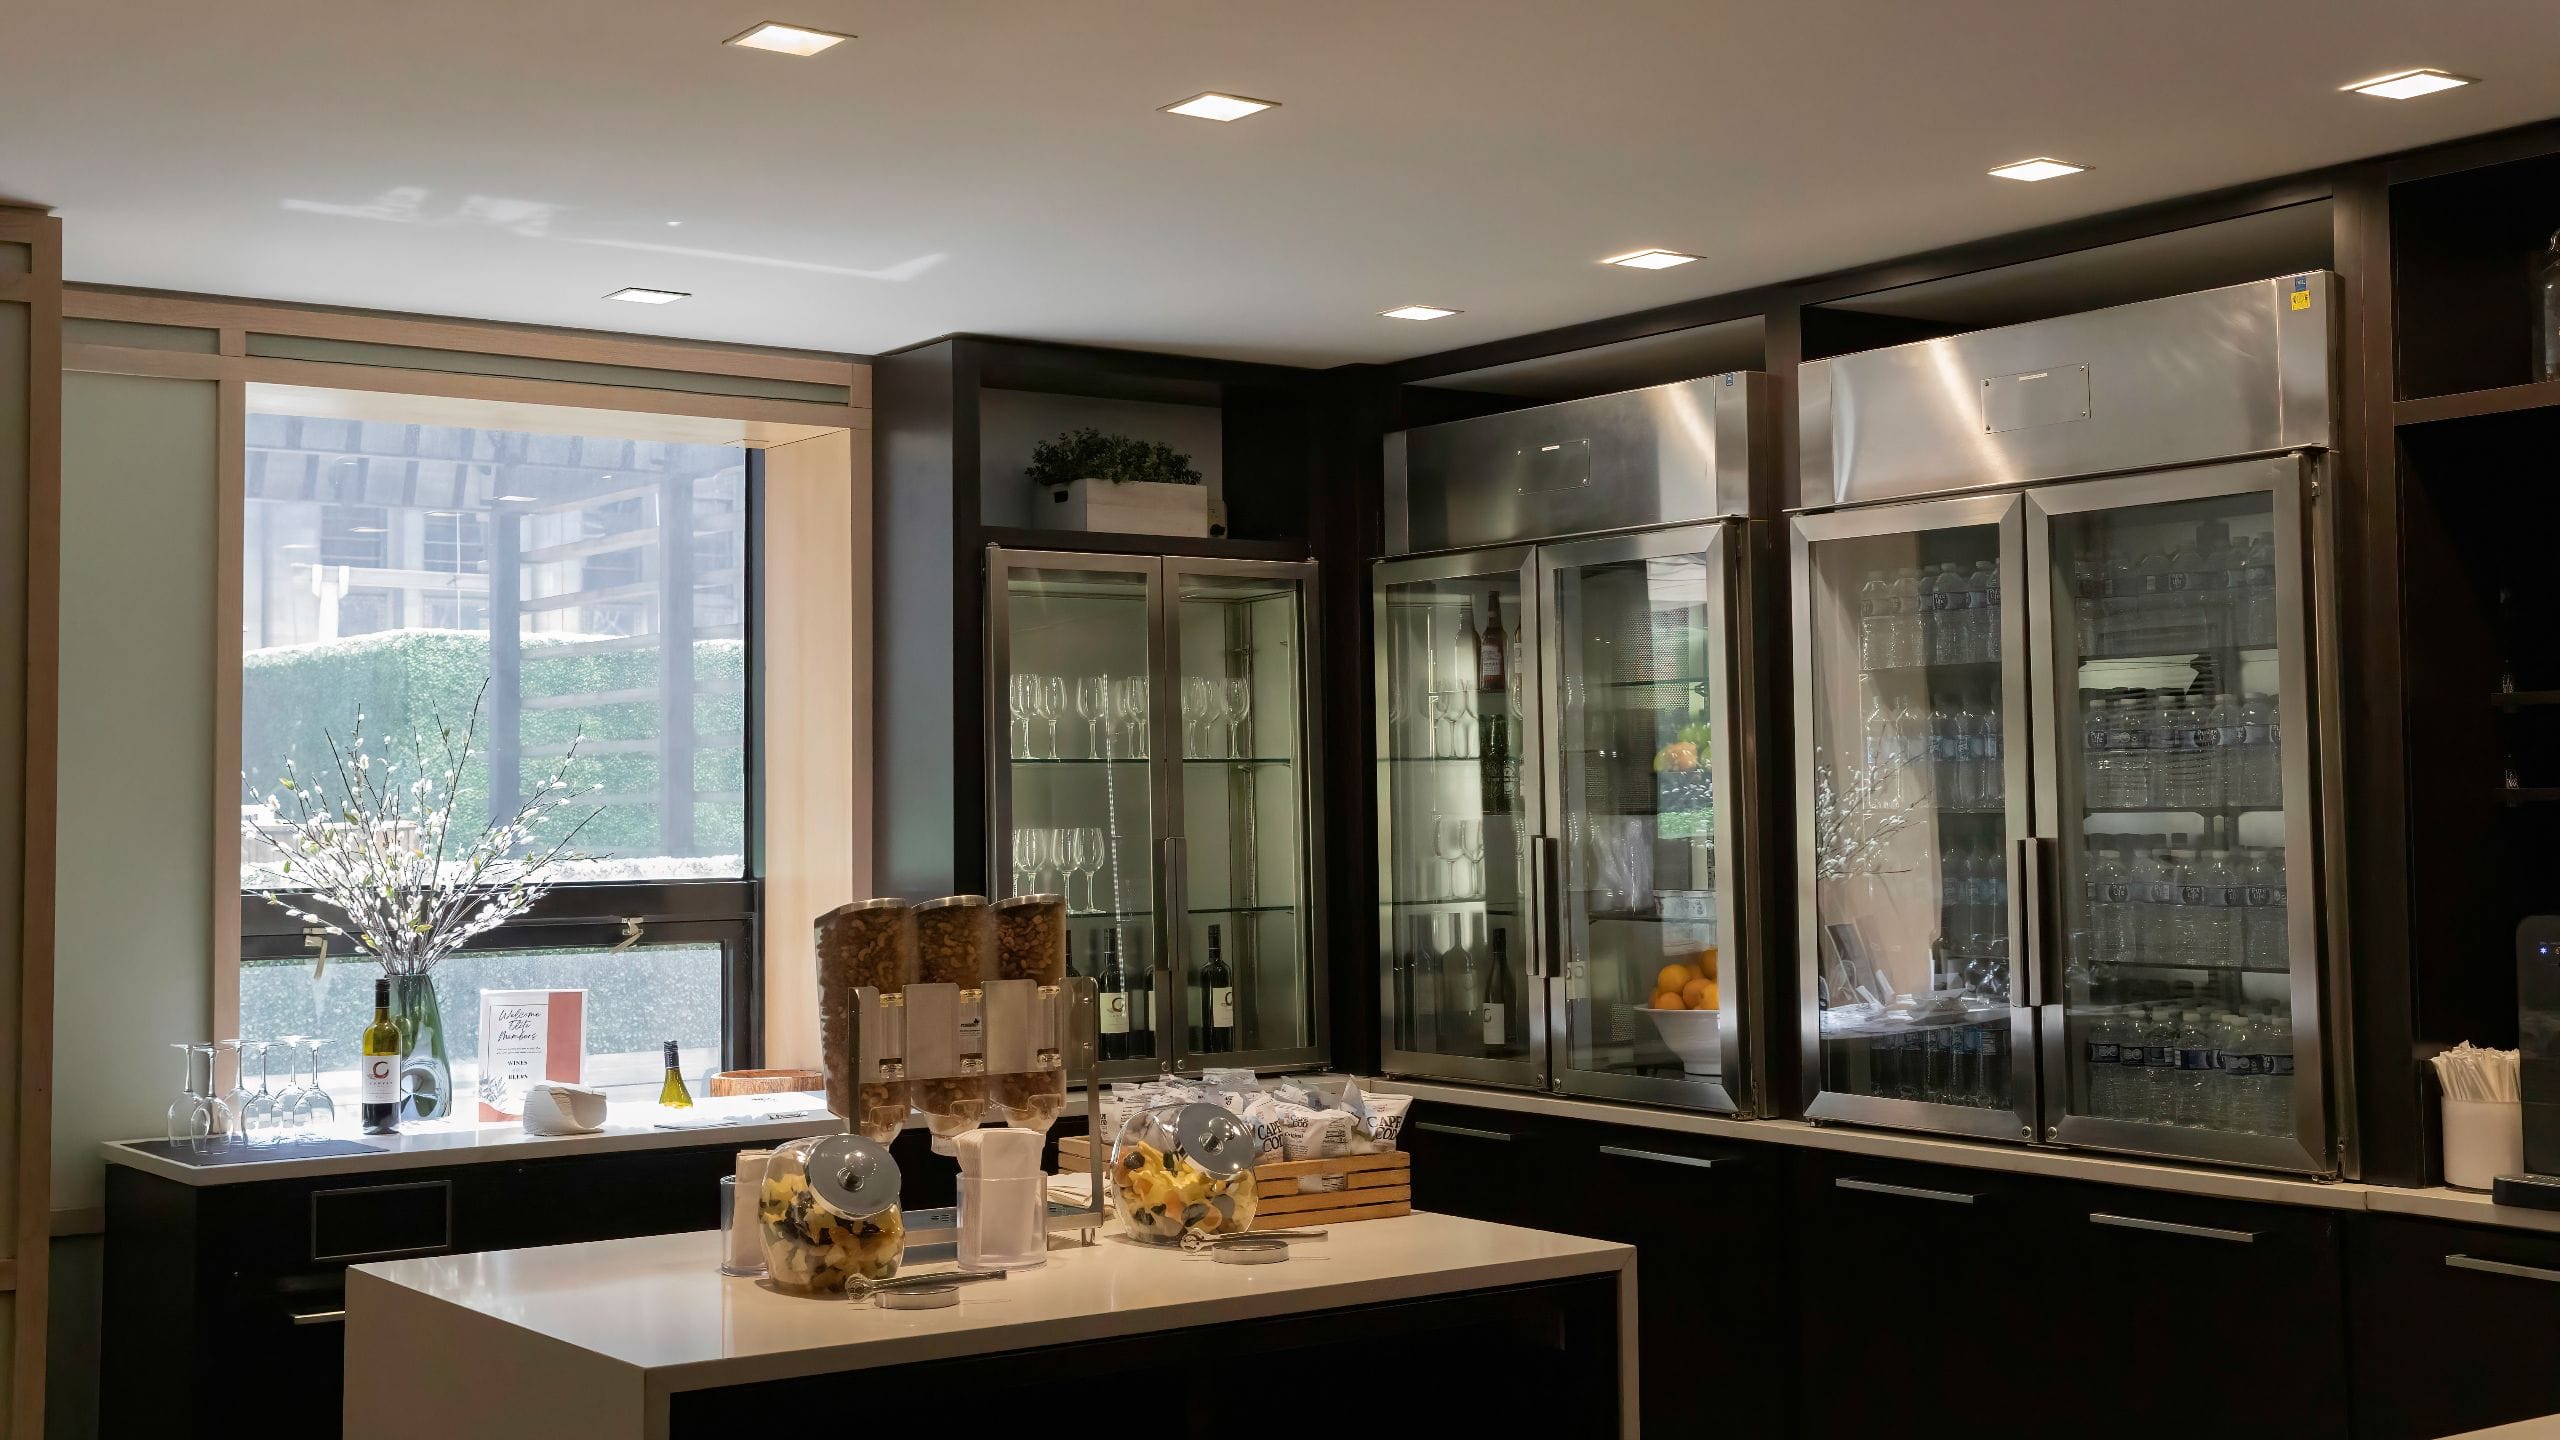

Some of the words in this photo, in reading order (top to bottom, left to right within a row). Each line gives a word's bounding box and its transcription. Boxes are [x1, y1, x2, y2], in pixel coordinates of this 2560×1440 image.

[498, 1008, 541, 1021] Welcome
[508, 1019, 531, 1031] Elite
[497, 1030, 537, 1042] Members
